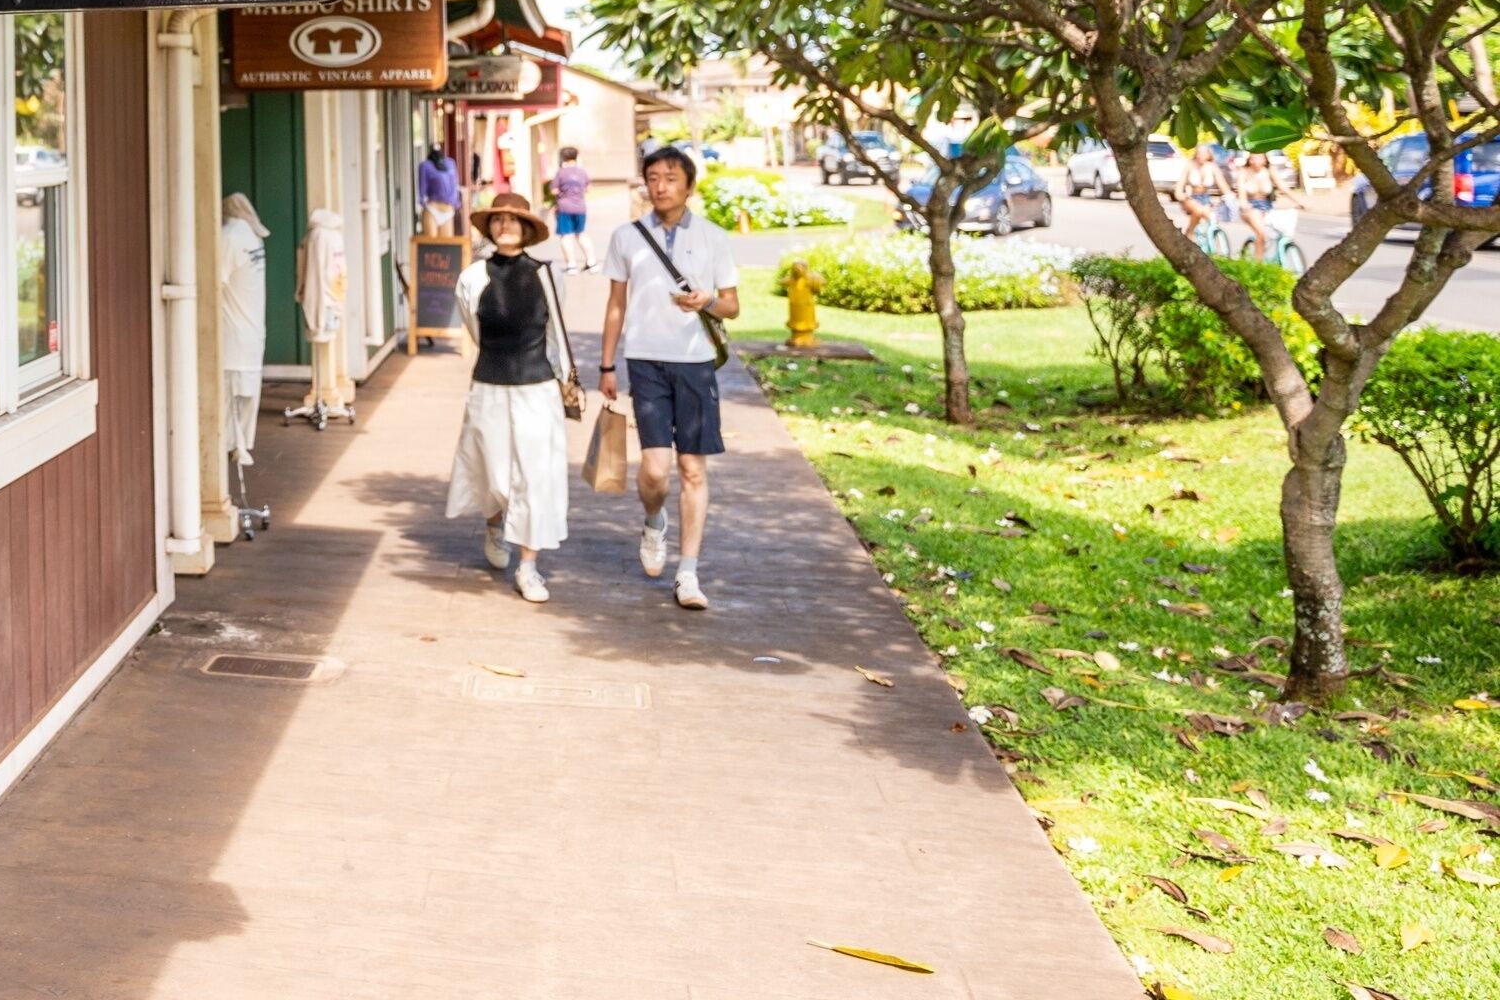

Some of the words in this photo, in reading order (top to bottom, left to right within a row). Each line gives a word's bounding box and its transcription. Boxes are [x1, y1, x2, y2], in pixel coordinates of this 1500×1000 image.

[240, 71, 312, 83] AUTHENTIC
[318, 70, 373, 81] VINTAGE
[379, 68, 434, 81] APPAREL
